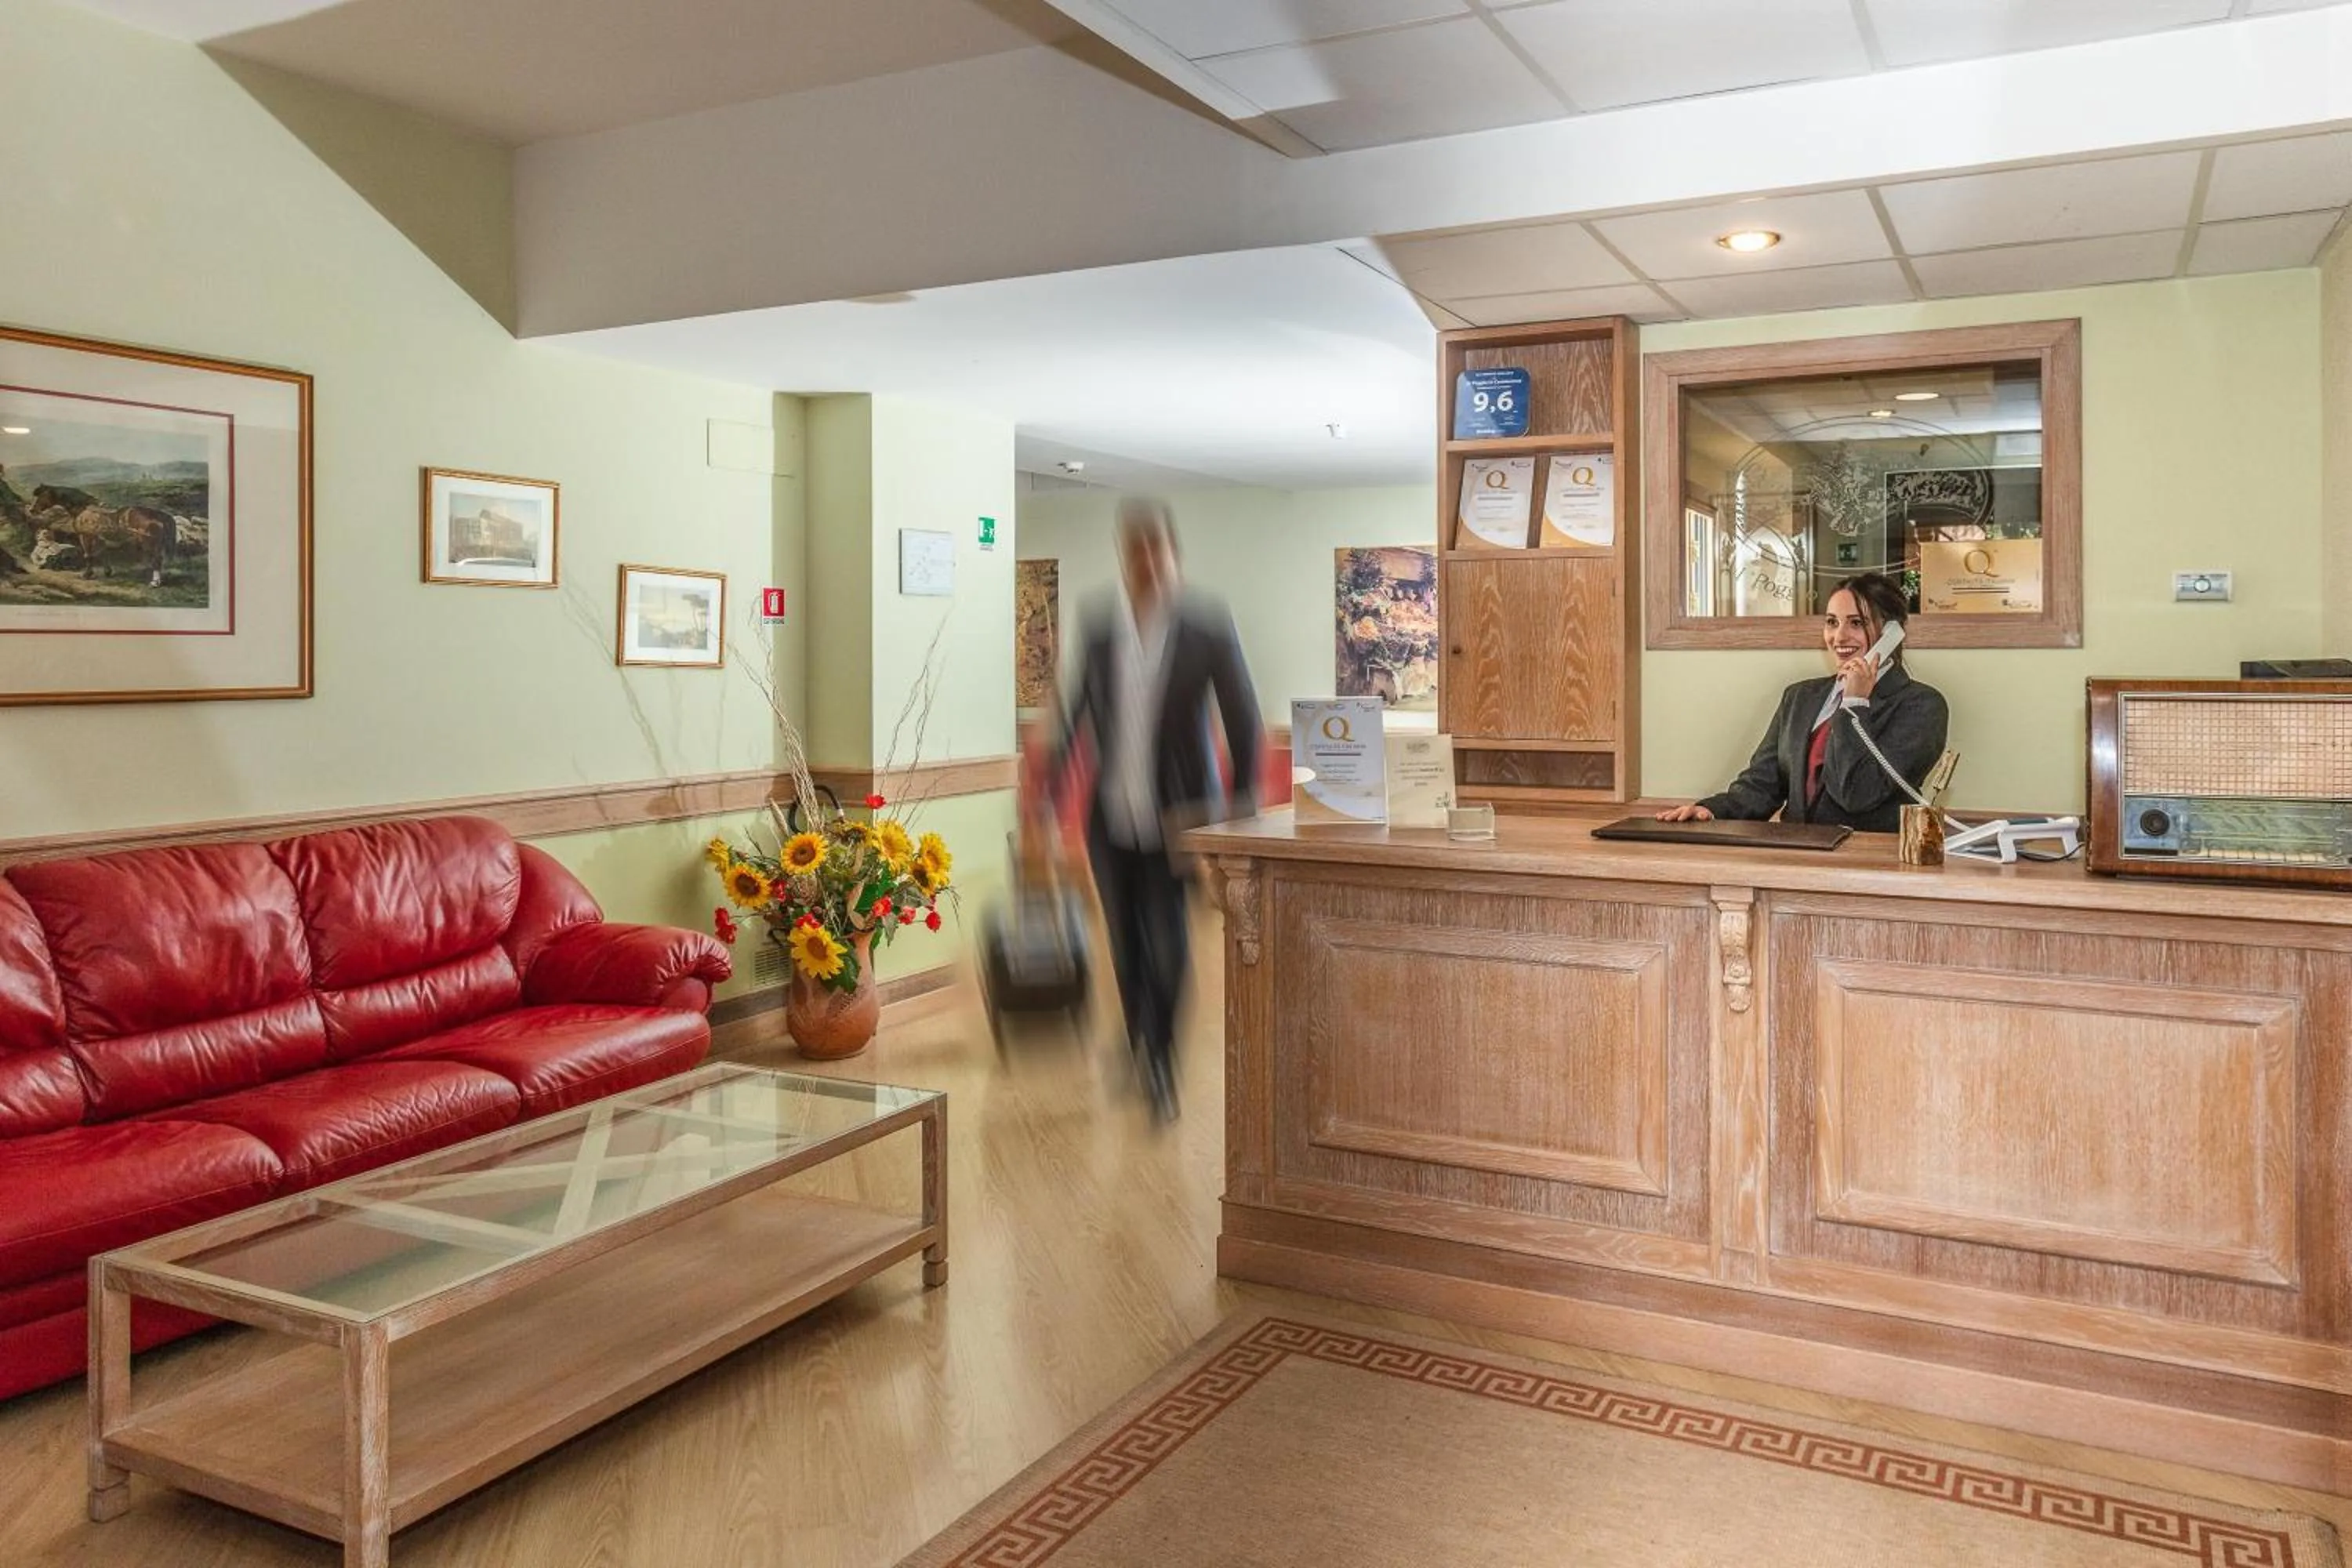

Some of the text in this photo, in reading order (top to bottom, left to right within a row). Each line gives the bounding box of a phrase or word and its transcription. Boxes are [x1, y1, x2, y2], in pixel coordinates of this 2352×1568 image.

[1473, 390, 1514, 412] 9,6
[1486, 470, 1510, 490] Q
[1572, 466, 1595, 487] Q
[1964, 550, 2001, 577] Q
[1323, 716, 1356, 742] Q
